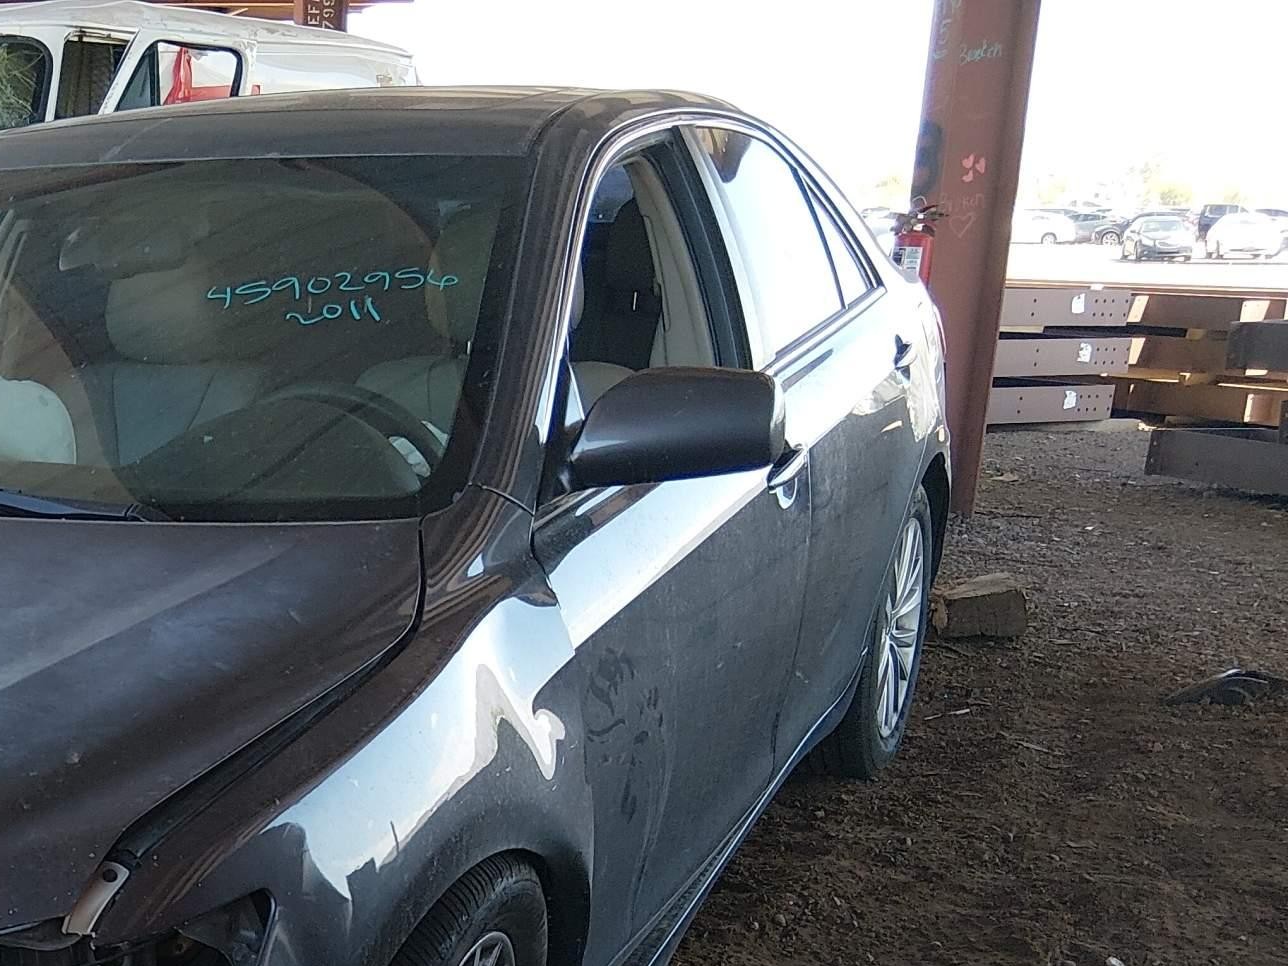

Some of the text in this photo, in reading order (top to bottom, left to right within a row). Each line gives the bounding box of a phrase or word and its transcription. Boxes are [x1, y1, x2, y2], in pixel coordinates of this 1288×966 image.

[307, 0, 321, 25] EF
[206, 267, 459, 310] 45902956
[285, 294, 383, 326] 2011
